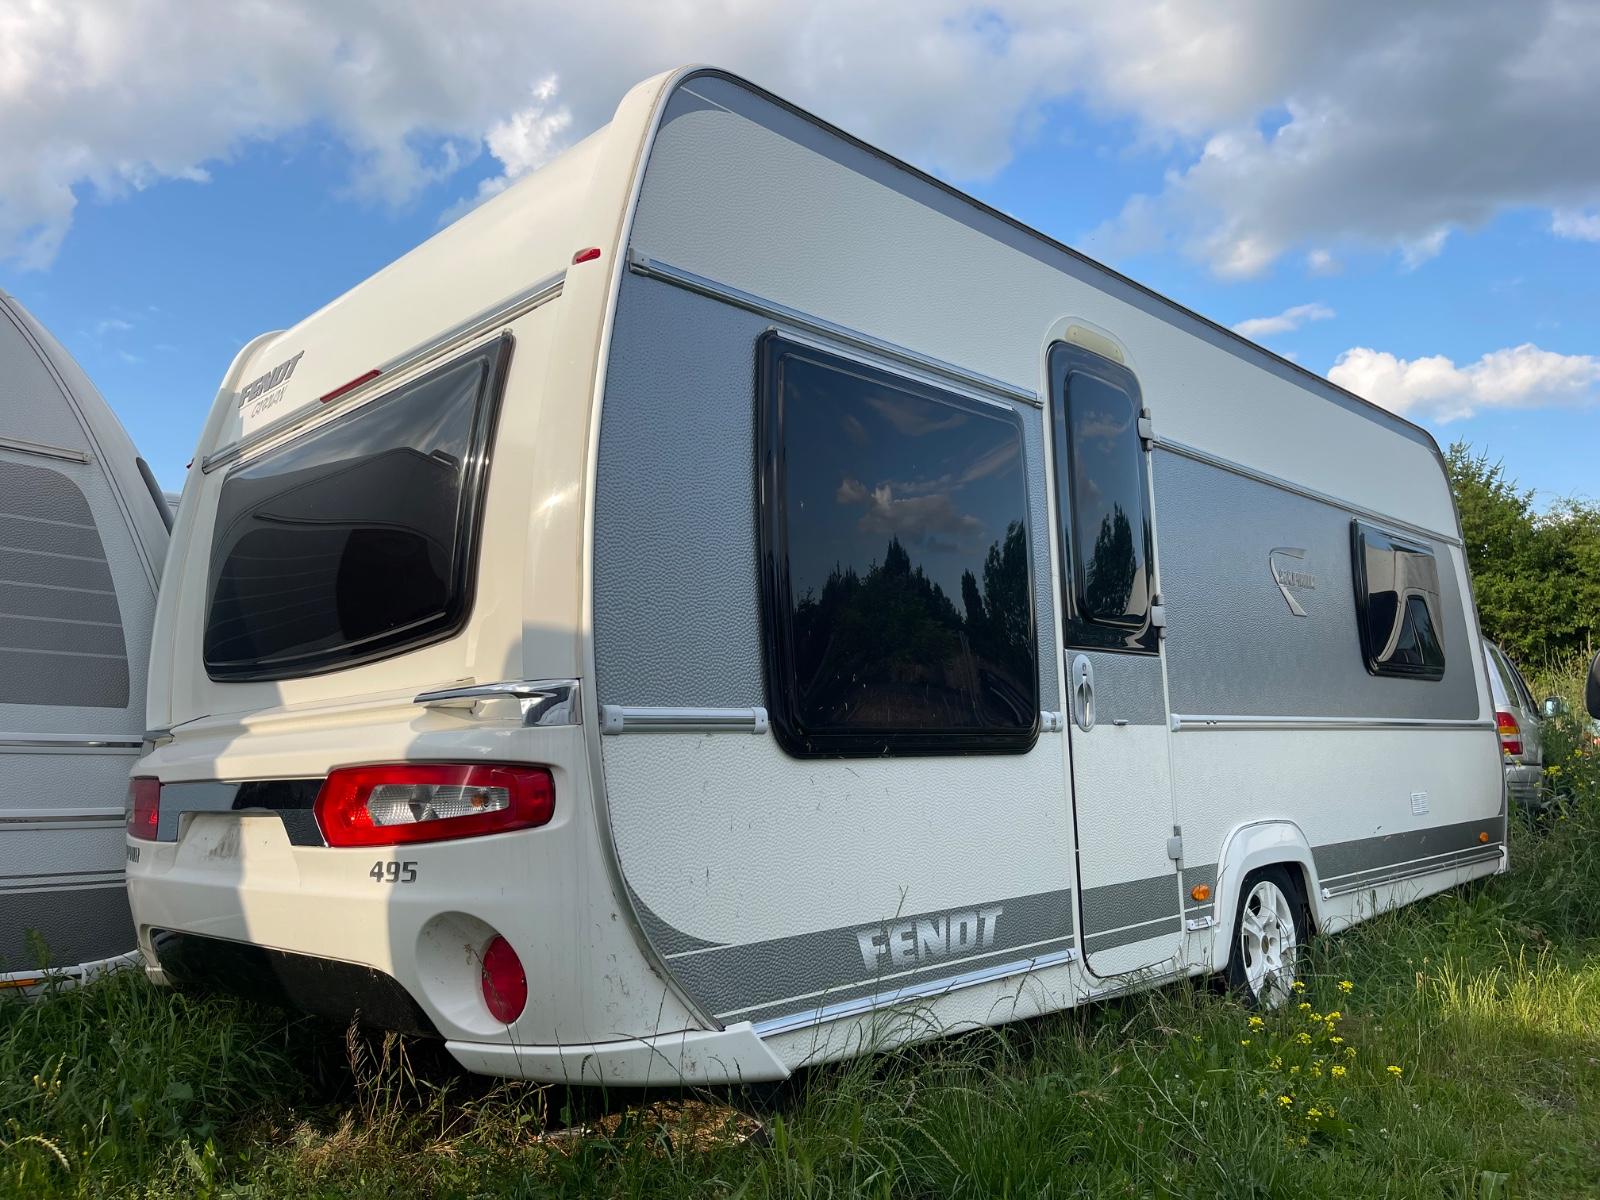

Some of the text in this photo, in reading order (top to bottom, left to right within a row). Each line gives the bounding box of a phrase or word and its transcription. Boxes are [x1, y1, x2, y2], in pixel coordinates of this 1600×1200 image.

[238, 350, 305, 408] FENDT
[370, 861, 418, 883] 495
[857, 907, 1003, 972] FENDT
